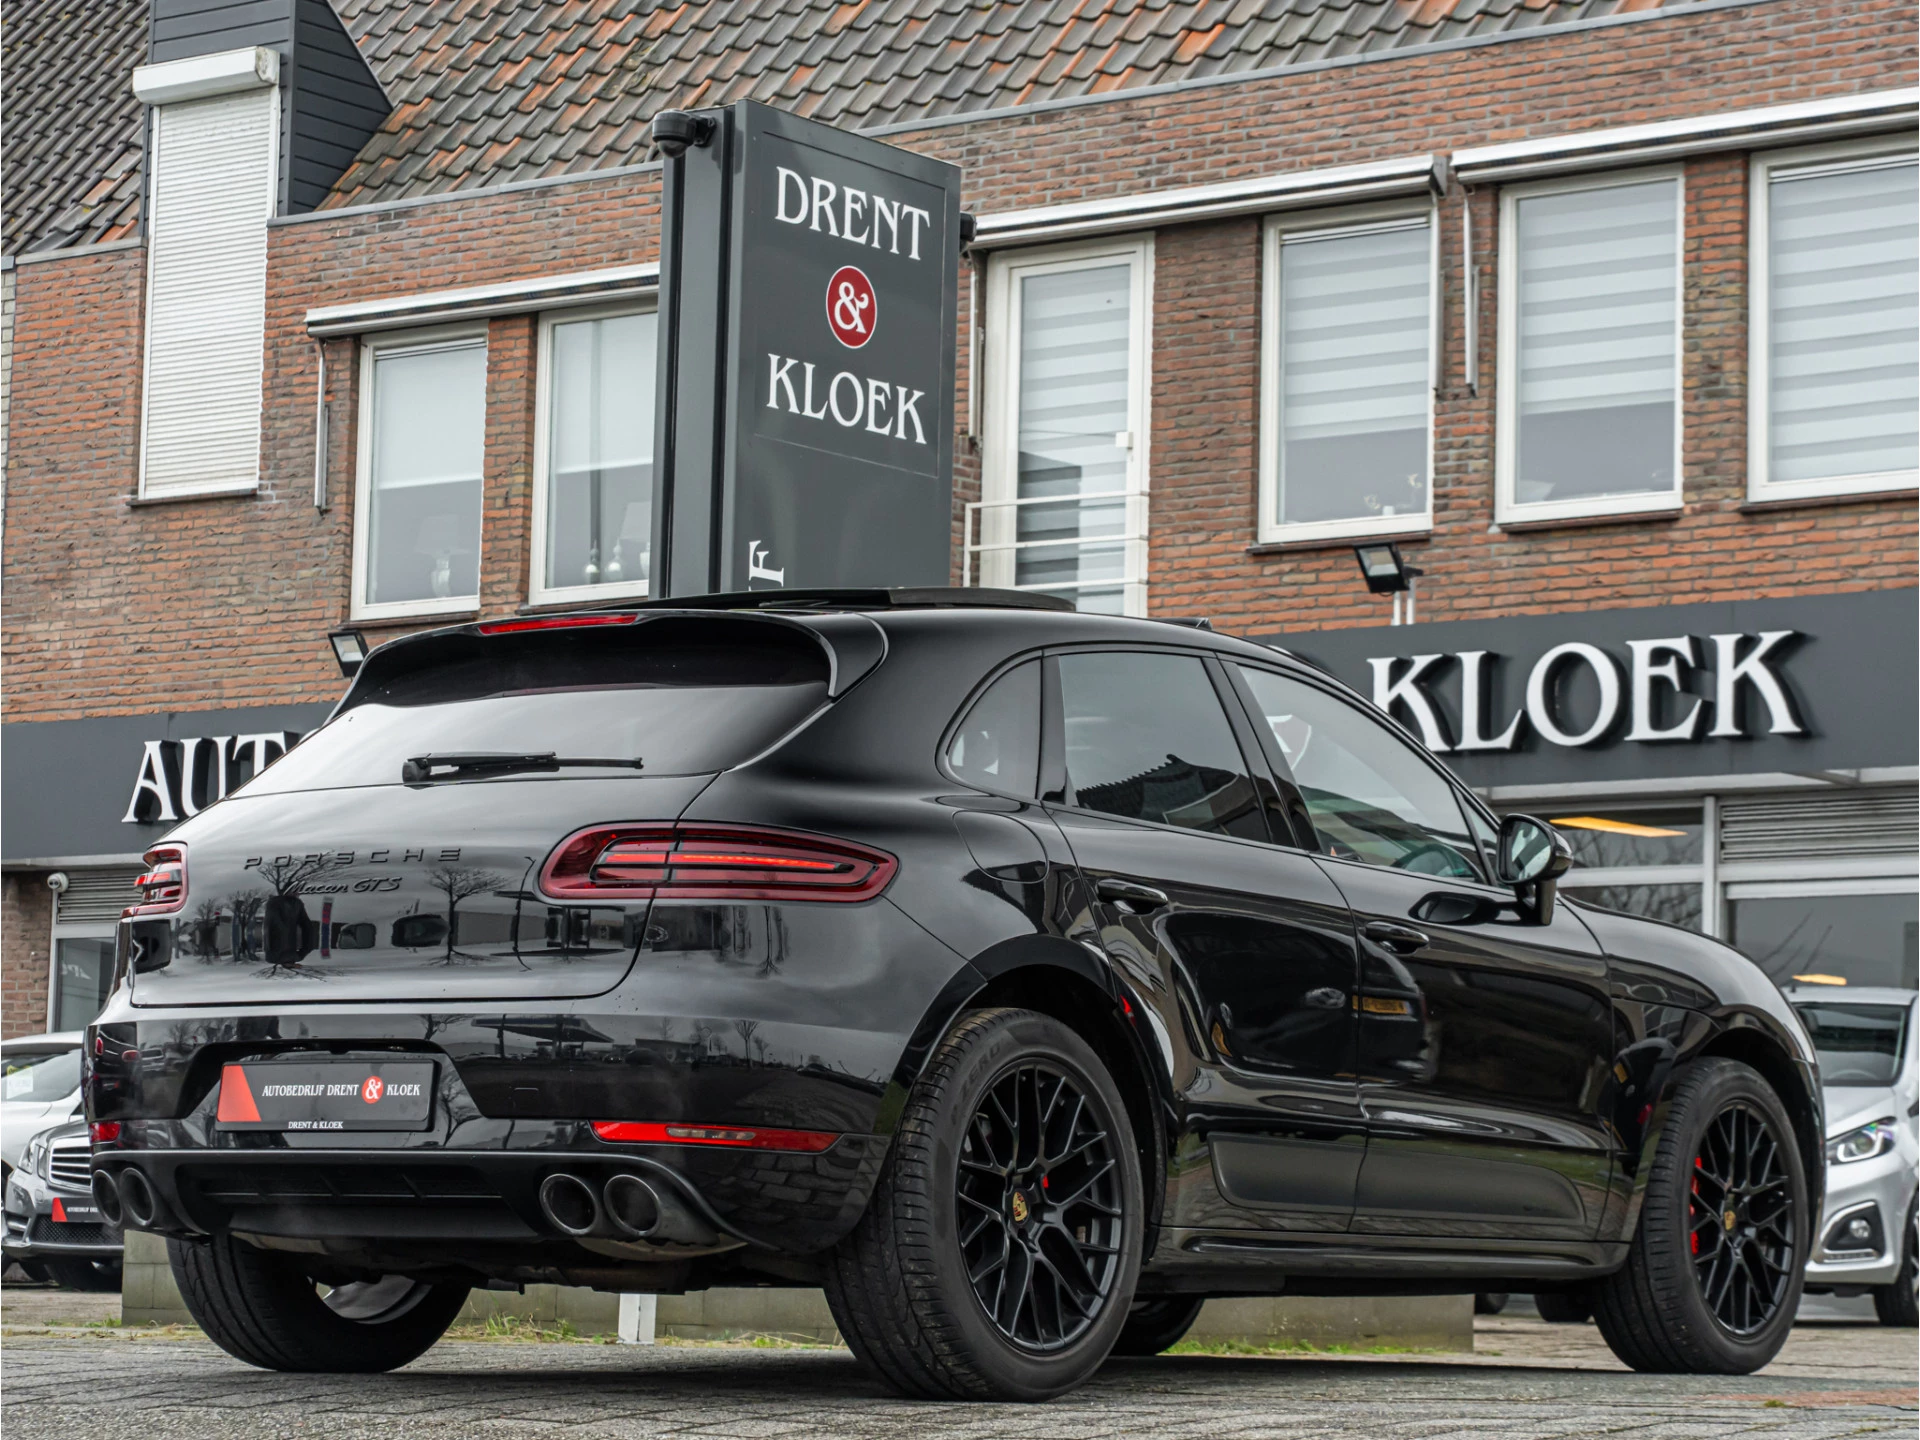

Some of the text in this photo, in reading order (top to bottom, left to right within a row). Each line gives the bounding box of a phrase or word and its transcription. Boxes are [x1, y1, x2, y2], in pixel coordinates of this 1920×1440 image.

[774, 165, 931, 261] DRENT
[834, 281, 870, 335] &
[766, 353, 928, 445] KLOEK
[748, 539, 785, 591] F
[1366, 630, 1804, 752] KLOEK
[244, 848, 461, 870] PORSCHE
[283, 876, 403, 896] Macan GTS
[262, 1078, 421, 1100] AUTOBEDRIJF DRENT & KLOEK
[288, 1121, 343, 1130] DRENT & KLOEK
